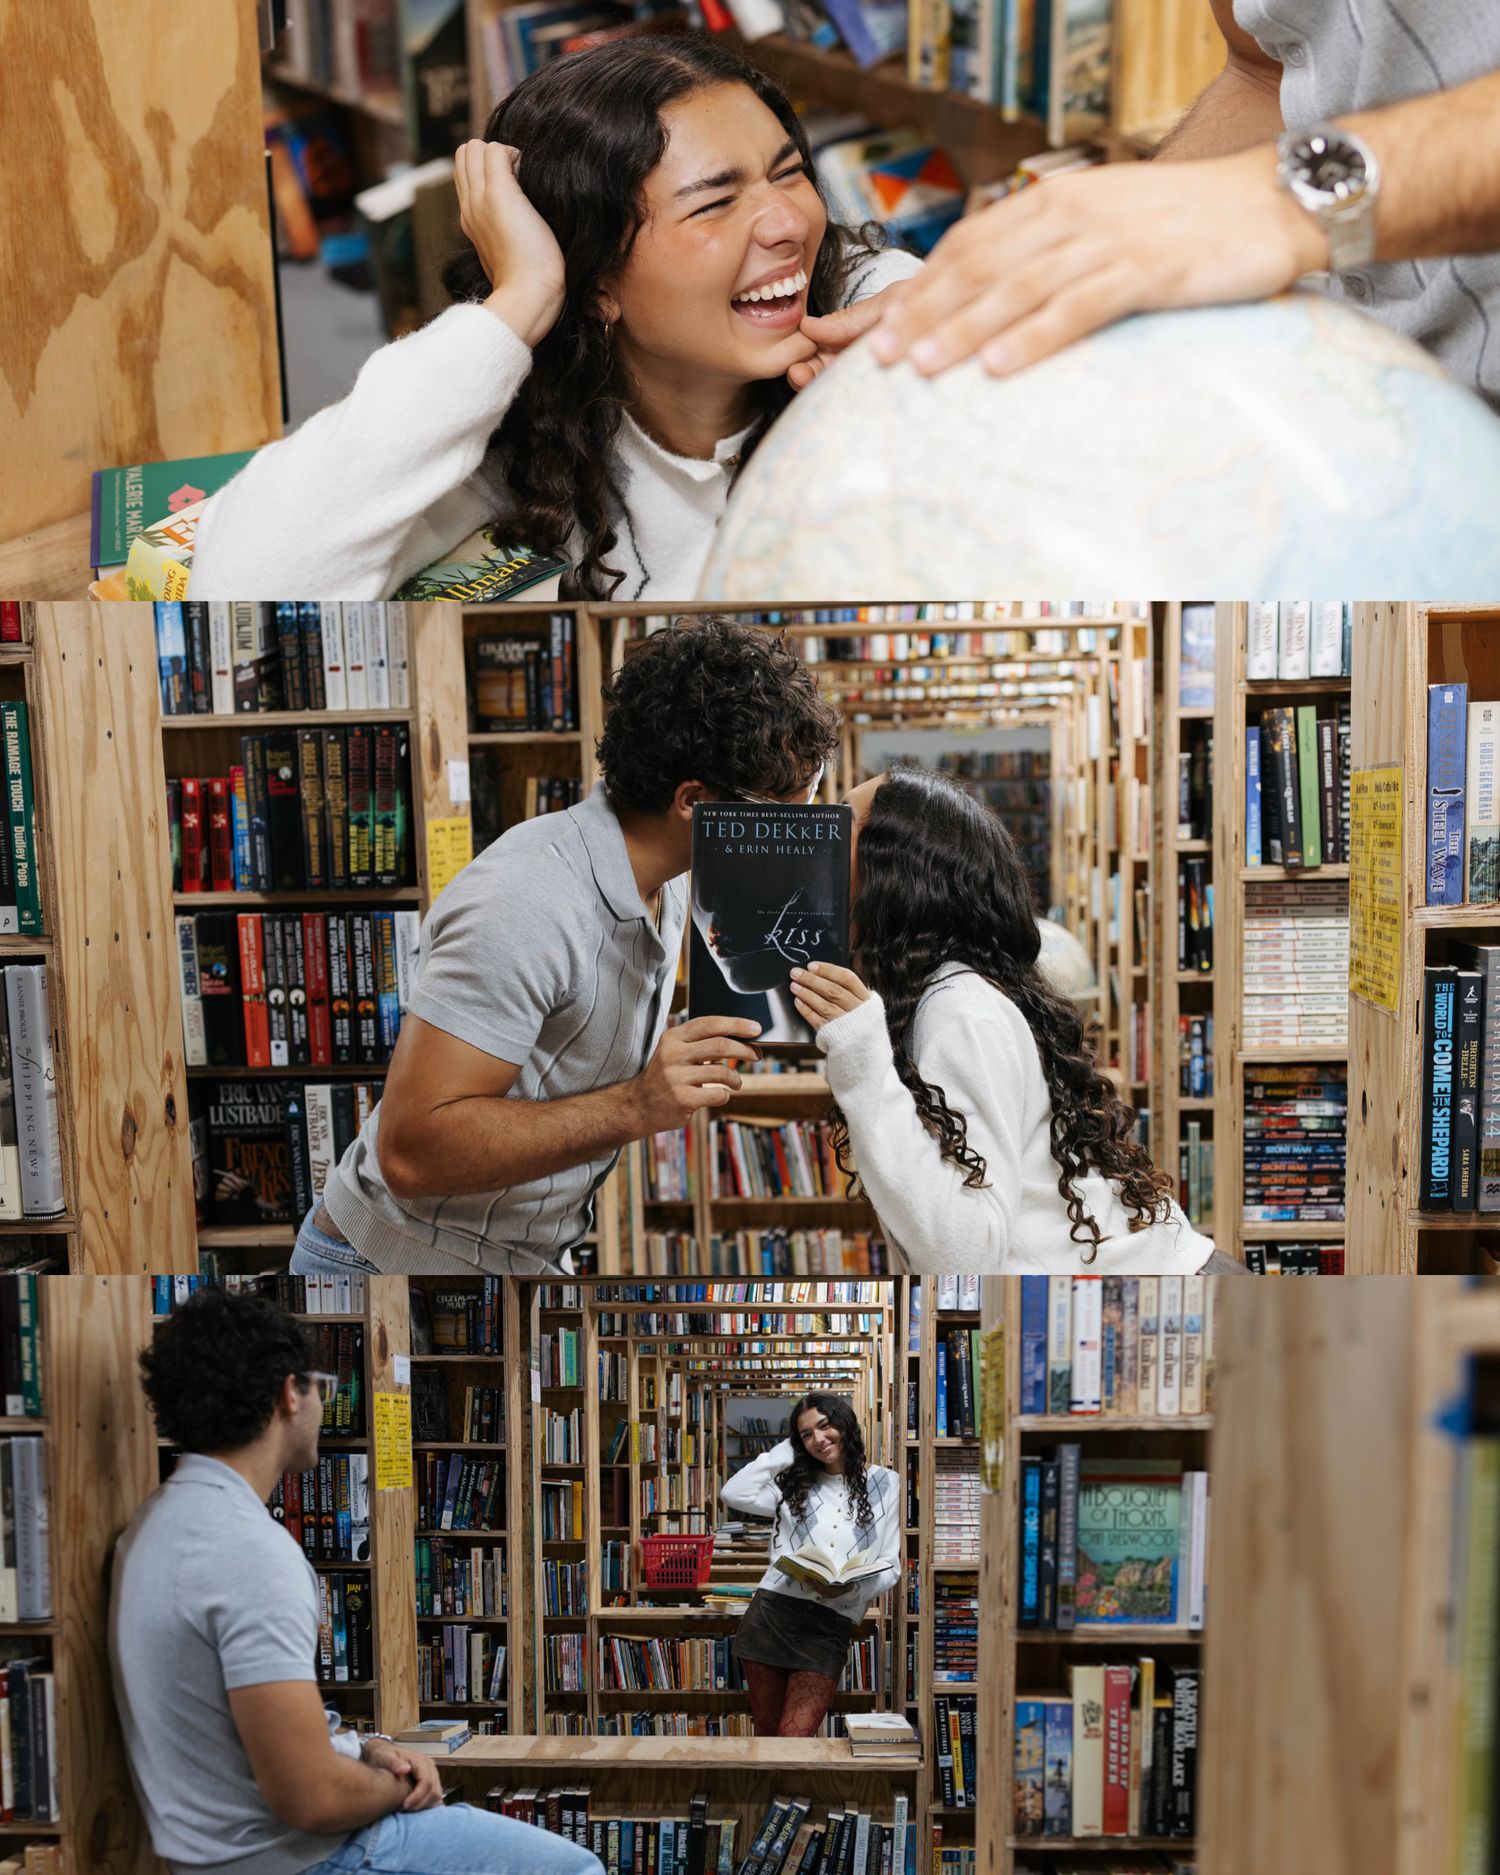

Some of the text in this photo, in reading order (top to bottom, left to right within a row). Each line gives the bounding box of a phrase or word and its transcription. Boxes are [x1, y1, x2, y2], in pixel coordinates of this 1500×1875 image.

[125, 466, 143, 508] VALERIE
[6, 710, 28, 888] THE RAMAGE TOUCH Dudley Pope
[702, 822, 843, 840] TED DEKKER
[1431, 801, 1448, 892] STEEL WAVE
[1449, 831, 1460, 854] THE
[725, 844, 815, 855] & ERIN HEALY
[329, 916, 337, 929] THE
[338, 920, 346, 952] ROBERT
[354, 917, 362, 929] THE
[363, 920, 371, 952] ROBERT
[1435, 983, 1454, 991] THE
[19, 1009, 27, 1039] PROULX
[1435, 992, 1448, 1028] WORLD
[1433, 1039, 1453, 1093] COME
[1460, 1049, 1468, 1078] BELLE
[1469, 1041, 1478, 1088] BRIGHTON
[219, 1084, 253, 1104] ERIC
[209, 1104, 286, 1126] LUSTBADE
[308, 1093, 320, 1151] LUSTBADER
[28, 1138, 39, 1177] NEWS
[1291, 1145, 1312, 1154] MAN
[1431, 1107, 1450, 1181] SHEPARD
[312, 1159, 330, 1196] ZERO
[1461, 1149, 1470, 1198] SARA SHERIDAN
[1095, 1485, 1168, 1507] BOUQUET
[1090, 1507, 1167, 1531] OF THORNS
[1107, 1532, 1175, 1547] SHERWOOD
[1108, 1708, 1118, 1784] THUNDER
[1173, 1752, 1185, 1787] LAKE
[895, 1801, 905, 1851] Fertile Ground
